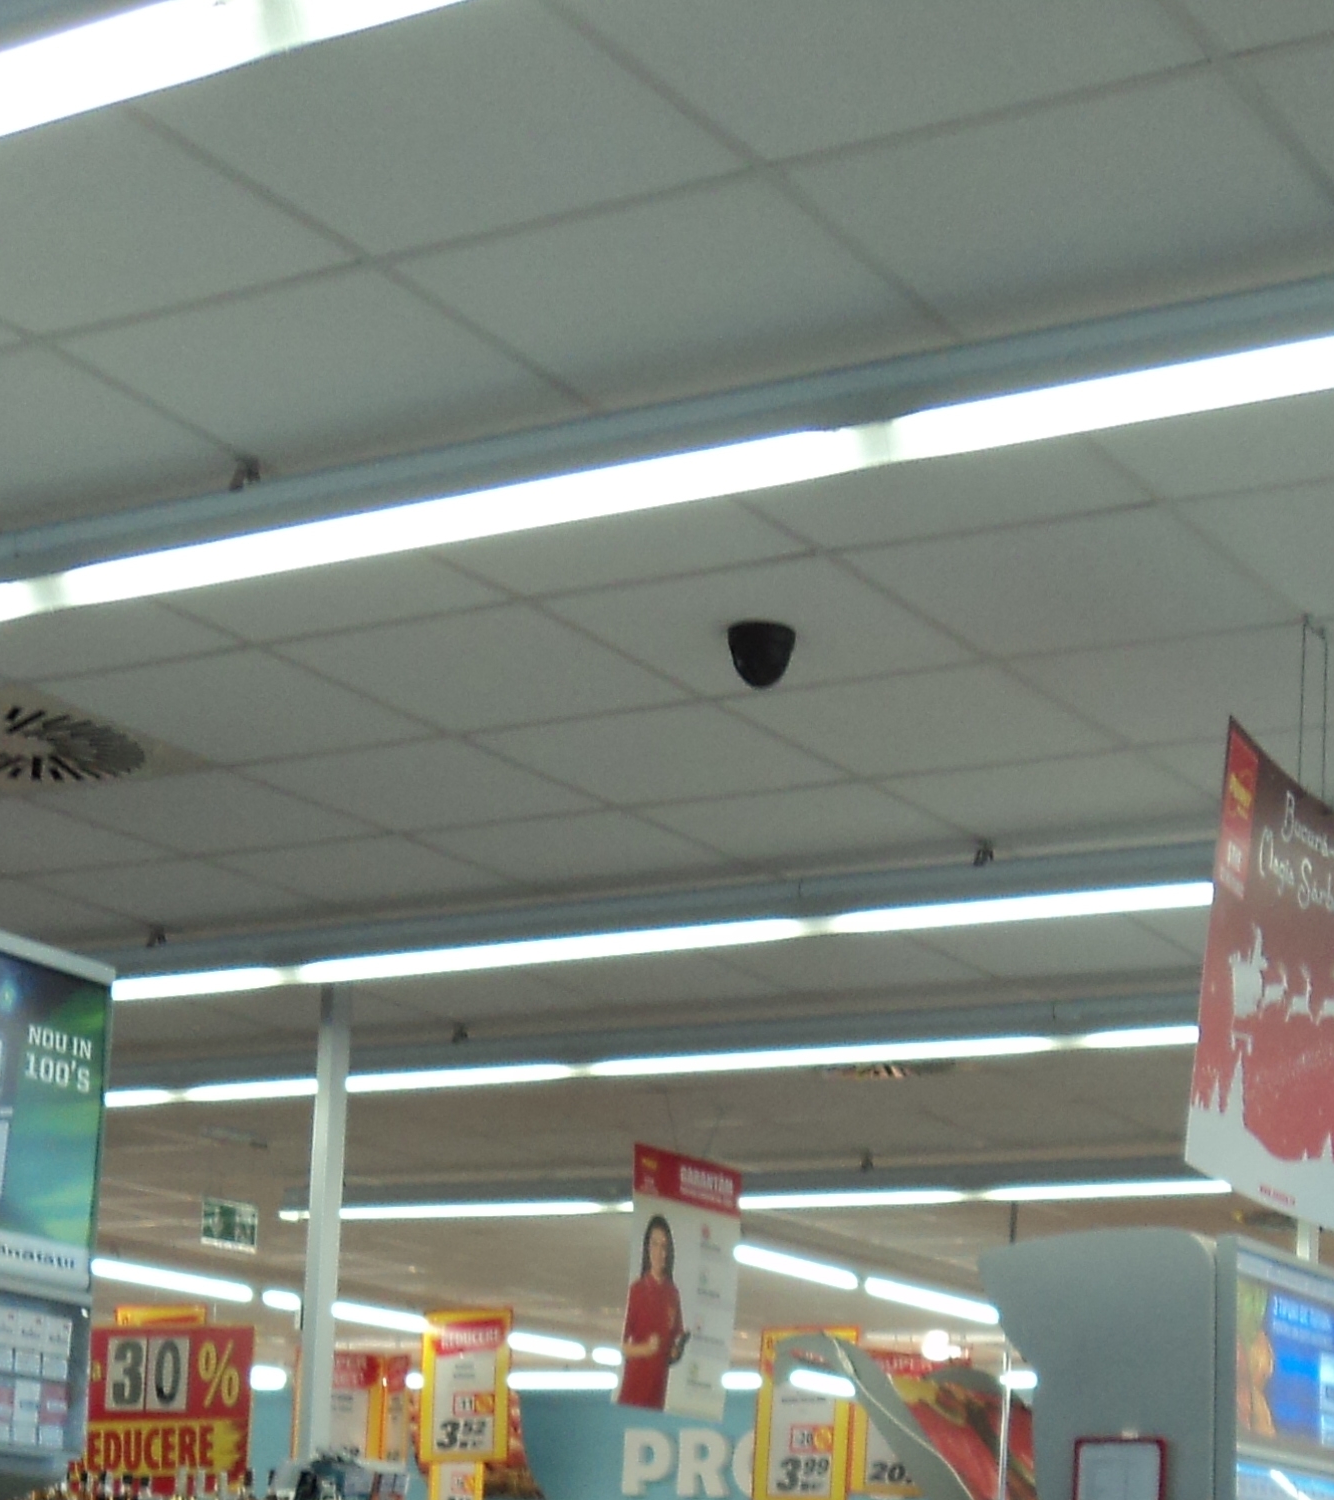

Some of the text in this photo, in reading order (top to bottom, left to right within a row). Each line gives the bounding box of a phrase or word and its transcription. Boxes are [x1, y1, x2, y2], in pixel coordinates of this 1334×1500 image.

[28, 1023, 67, 1054] NOU
[24, 1052, 91, 1094] 100'S
[87, 1424, 214, 1473] EDUCERE
